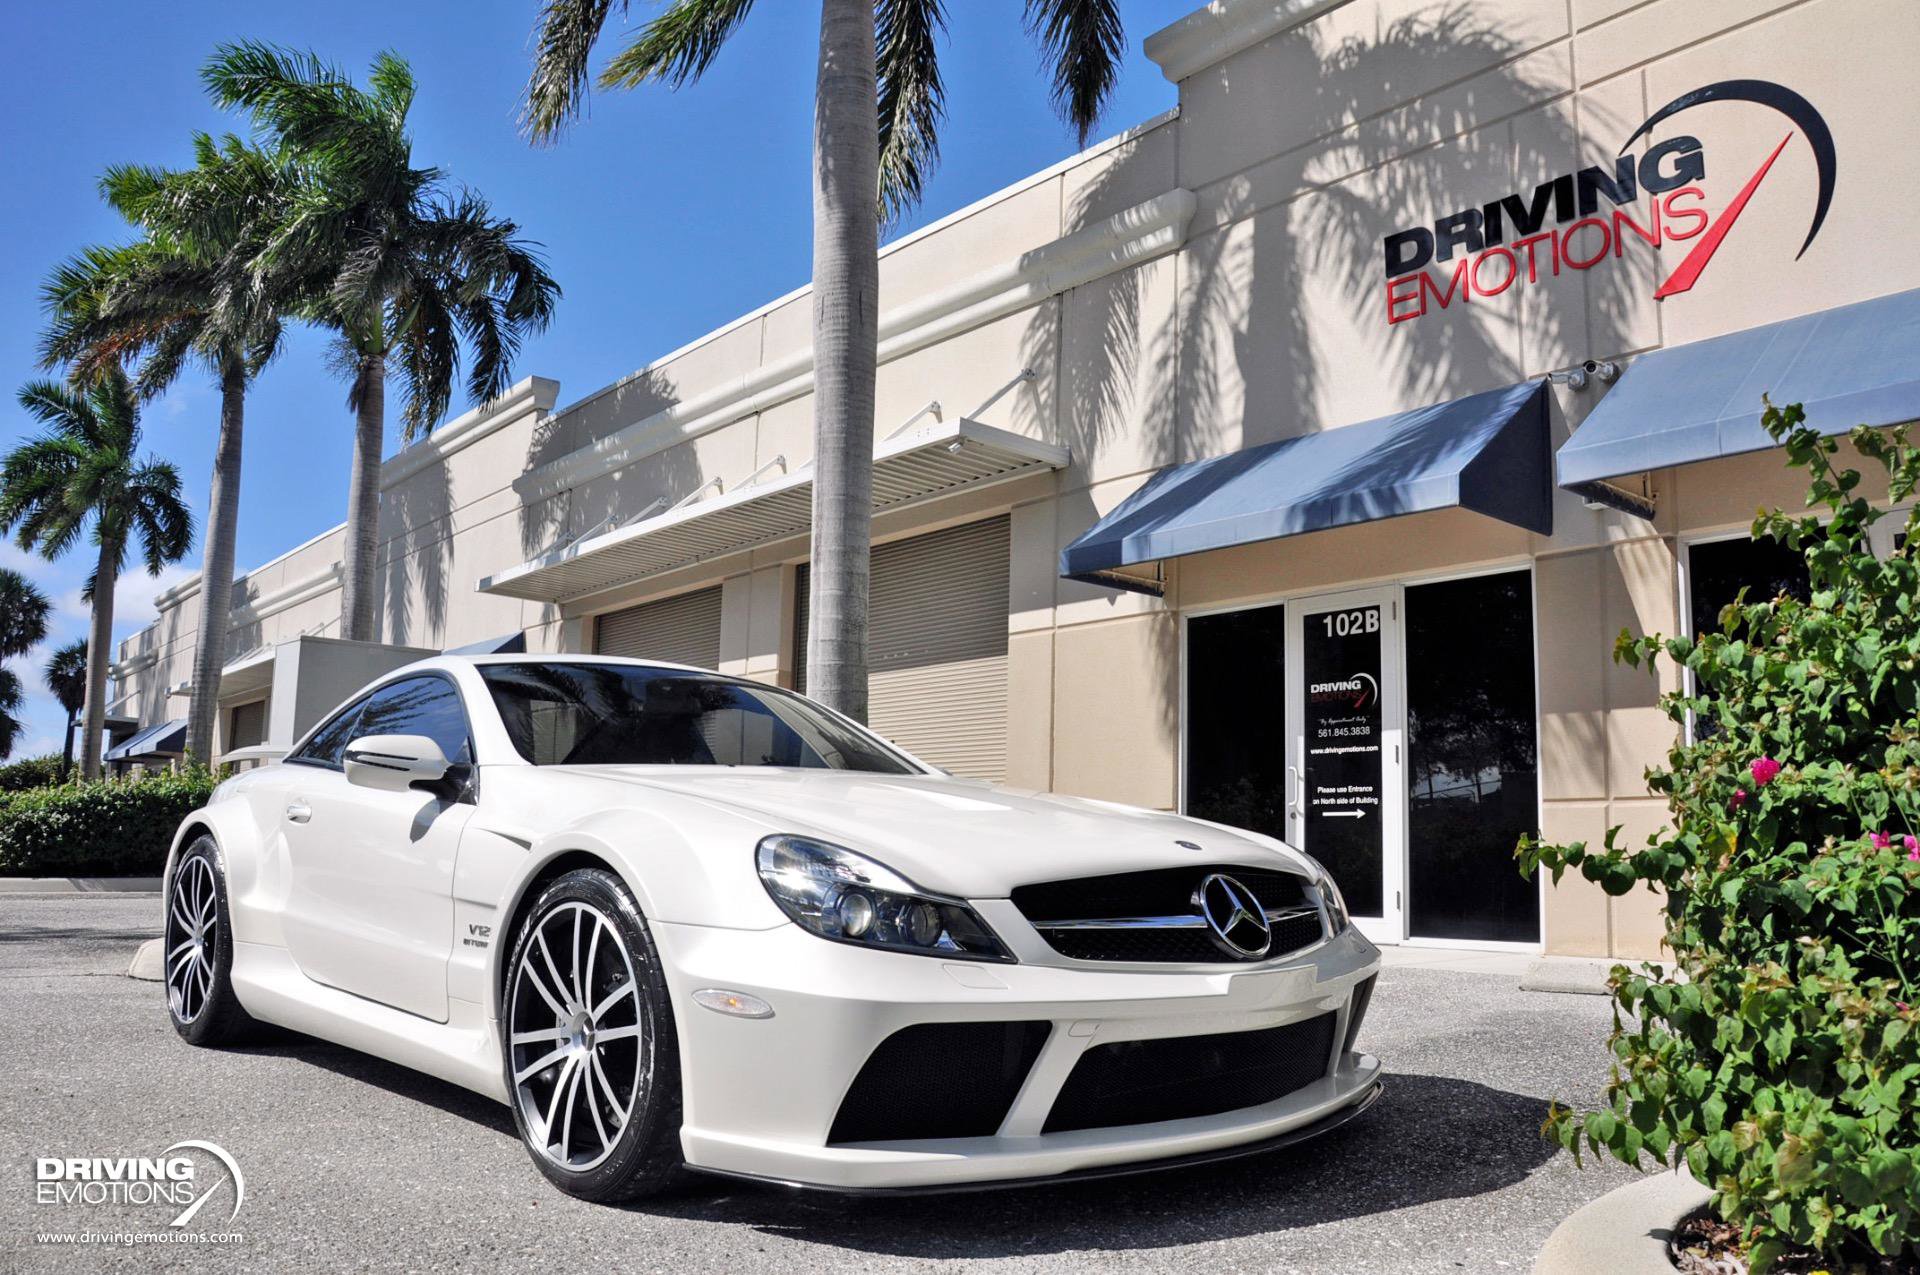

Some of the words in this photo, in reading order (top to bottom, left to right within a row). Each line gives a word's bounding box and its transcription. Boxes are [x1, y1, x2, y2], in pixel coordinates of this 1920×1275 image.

[1384, 135, 1706, 279] DRIVING
[1386, 187, 1709, 325] EMOTIONS
[1323, 609, 1379, 637] 102B
[1310, 680, 1361, 694] DRIVING
[1318, 726, 1370, 737] 561.845.3838
[1310, 746, 1378, 754] www.drivingemotions.com
[1317, 786, 1336, 794] Please
[1348, 785, 1373, 793] Entrance
[1321, 797, 1336, 805] North
[1356, 796, 1379, 805] Building
[469, 924, 491, 937] V12
